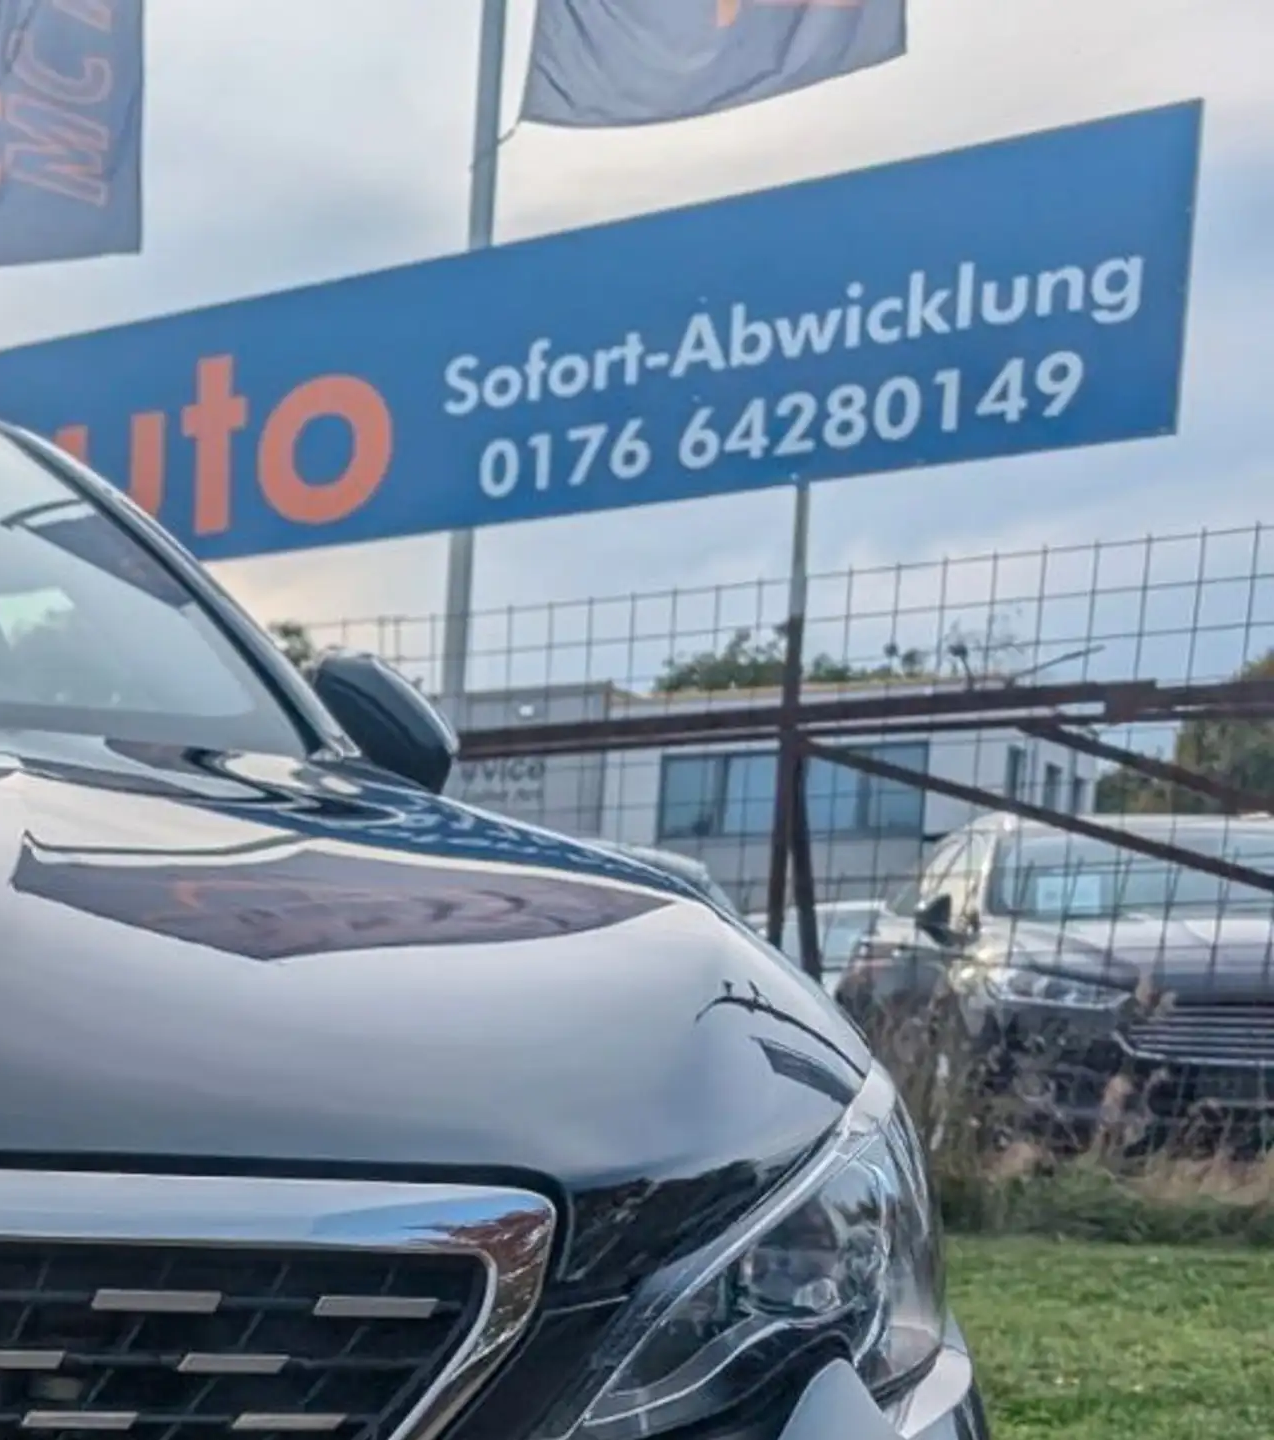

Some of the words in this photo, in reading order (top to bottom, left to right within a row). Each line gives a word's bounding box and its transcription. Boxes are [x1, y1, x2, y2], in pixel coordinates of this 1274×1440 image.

[4, 0, 112, 207] MC
[442, 254, 1144, 416] Sofort-Abwicklung
[52, 353, 393, 537] uto
[477, 417, 651, 498] 0176
[677, 349, 1085, 470] 64280149
